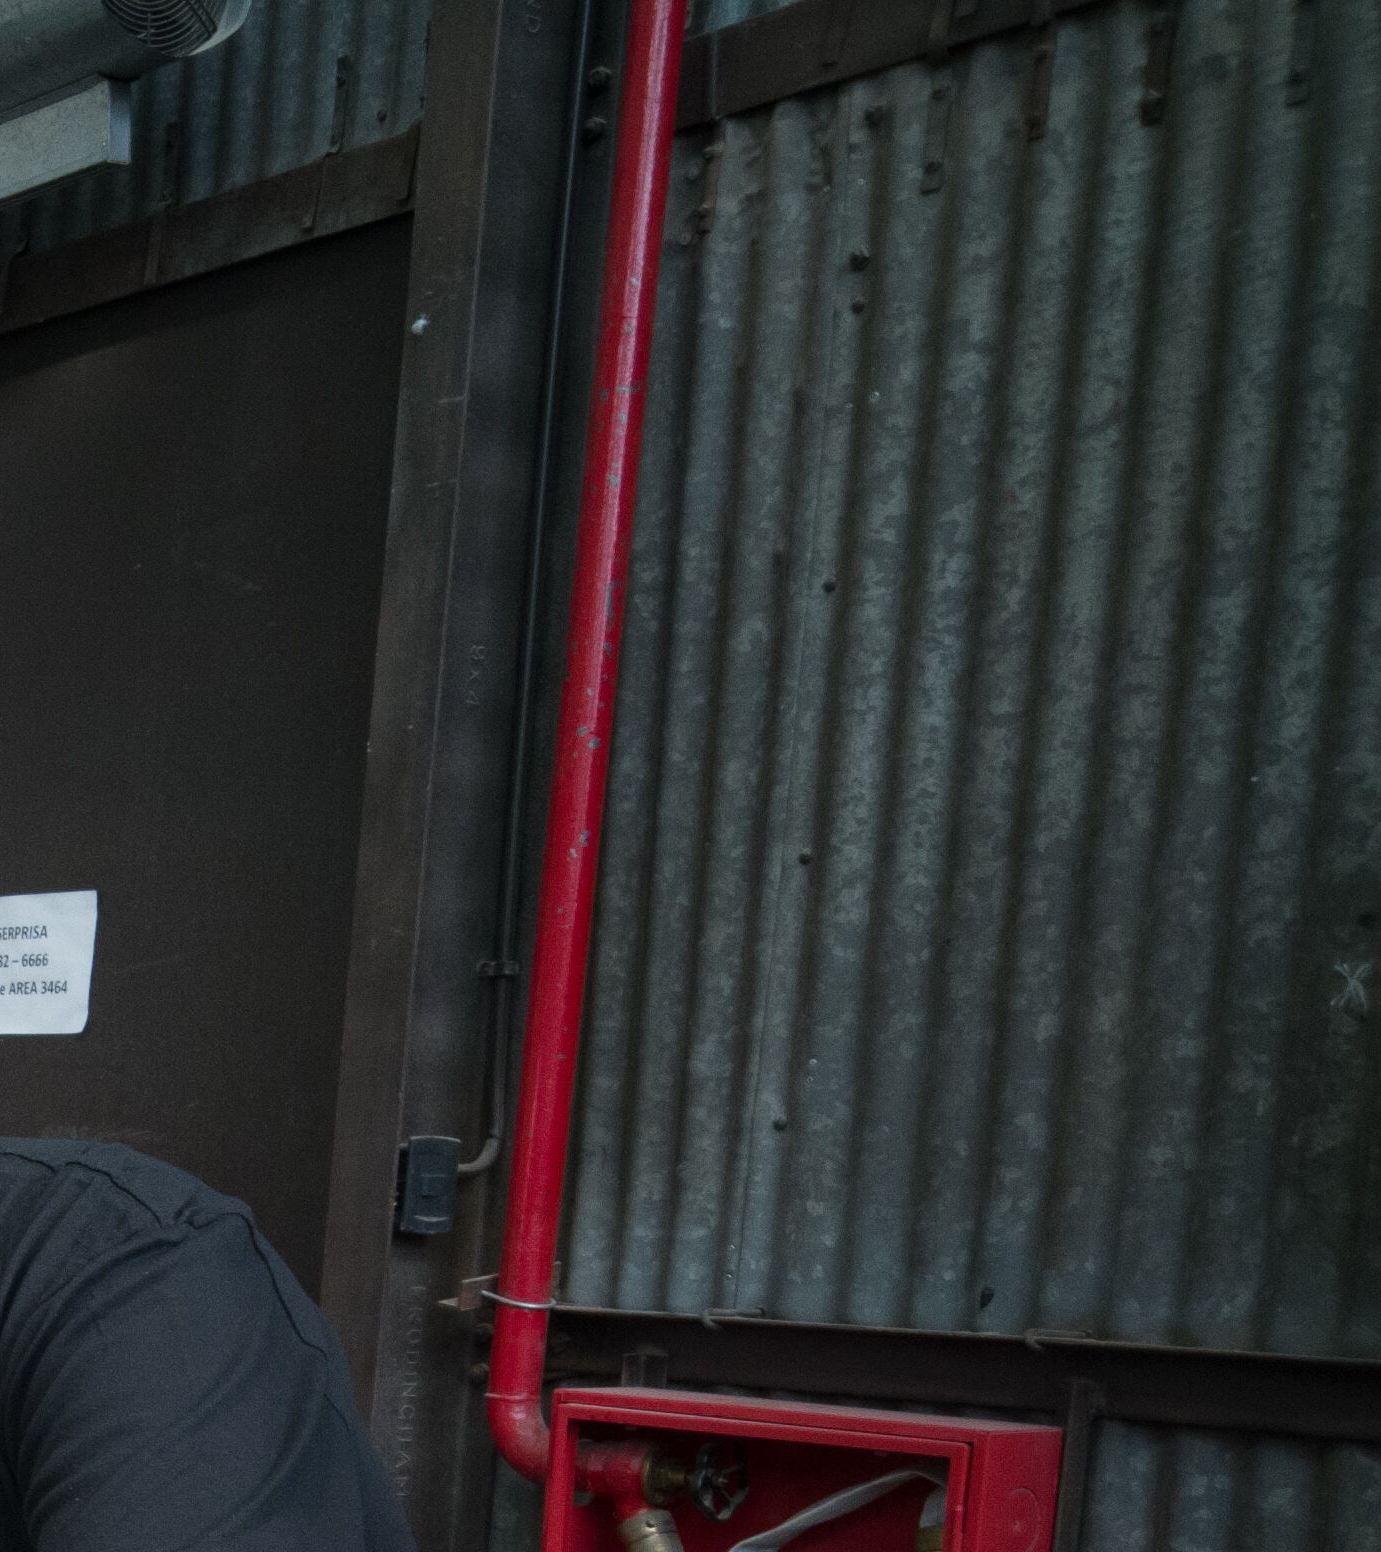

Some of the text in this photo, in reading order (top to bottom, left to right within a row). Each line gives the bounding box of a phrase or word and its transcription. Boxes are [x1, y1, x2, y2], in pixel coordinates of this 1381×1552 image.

[21, 953, 49, 967] 6666
[8, 981, 37, 995] AREA
[41, 980, 68, 994] 3464
